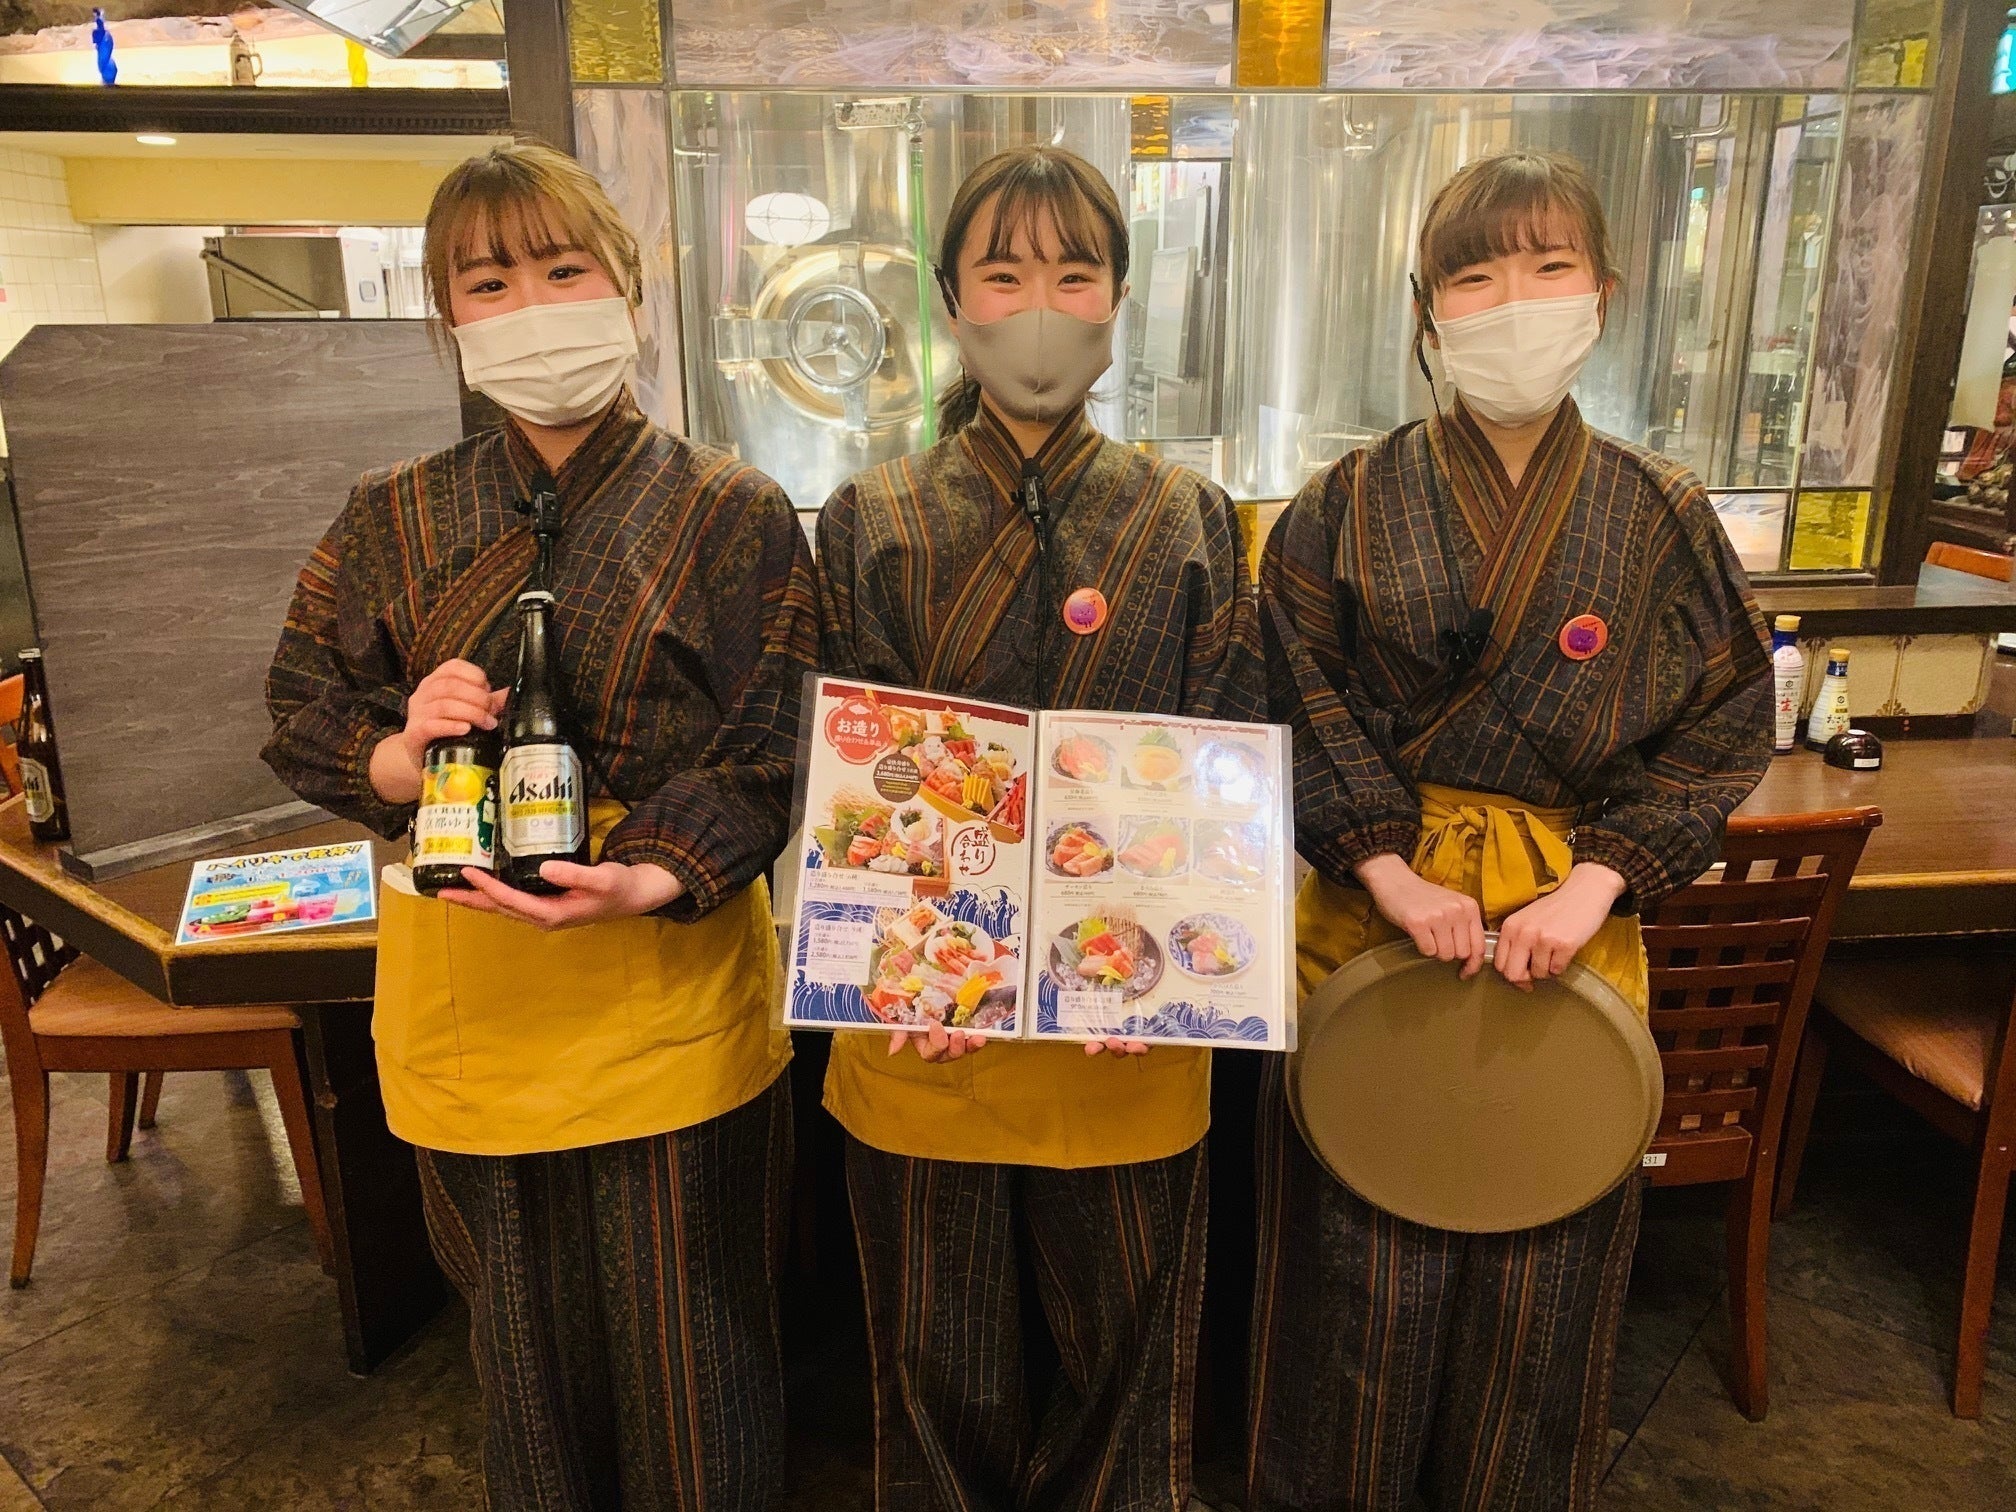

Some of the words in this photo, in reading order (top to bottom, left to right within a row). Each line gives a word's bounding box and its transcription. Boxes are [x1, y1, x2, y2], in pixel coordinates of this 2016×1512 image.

[1781, 698, 1792, 712] 生
[837, 718, 880, 738] お造り
[509, 775, 573, 804] Asahi
[1644, 1156, 1658, 1165] 31
